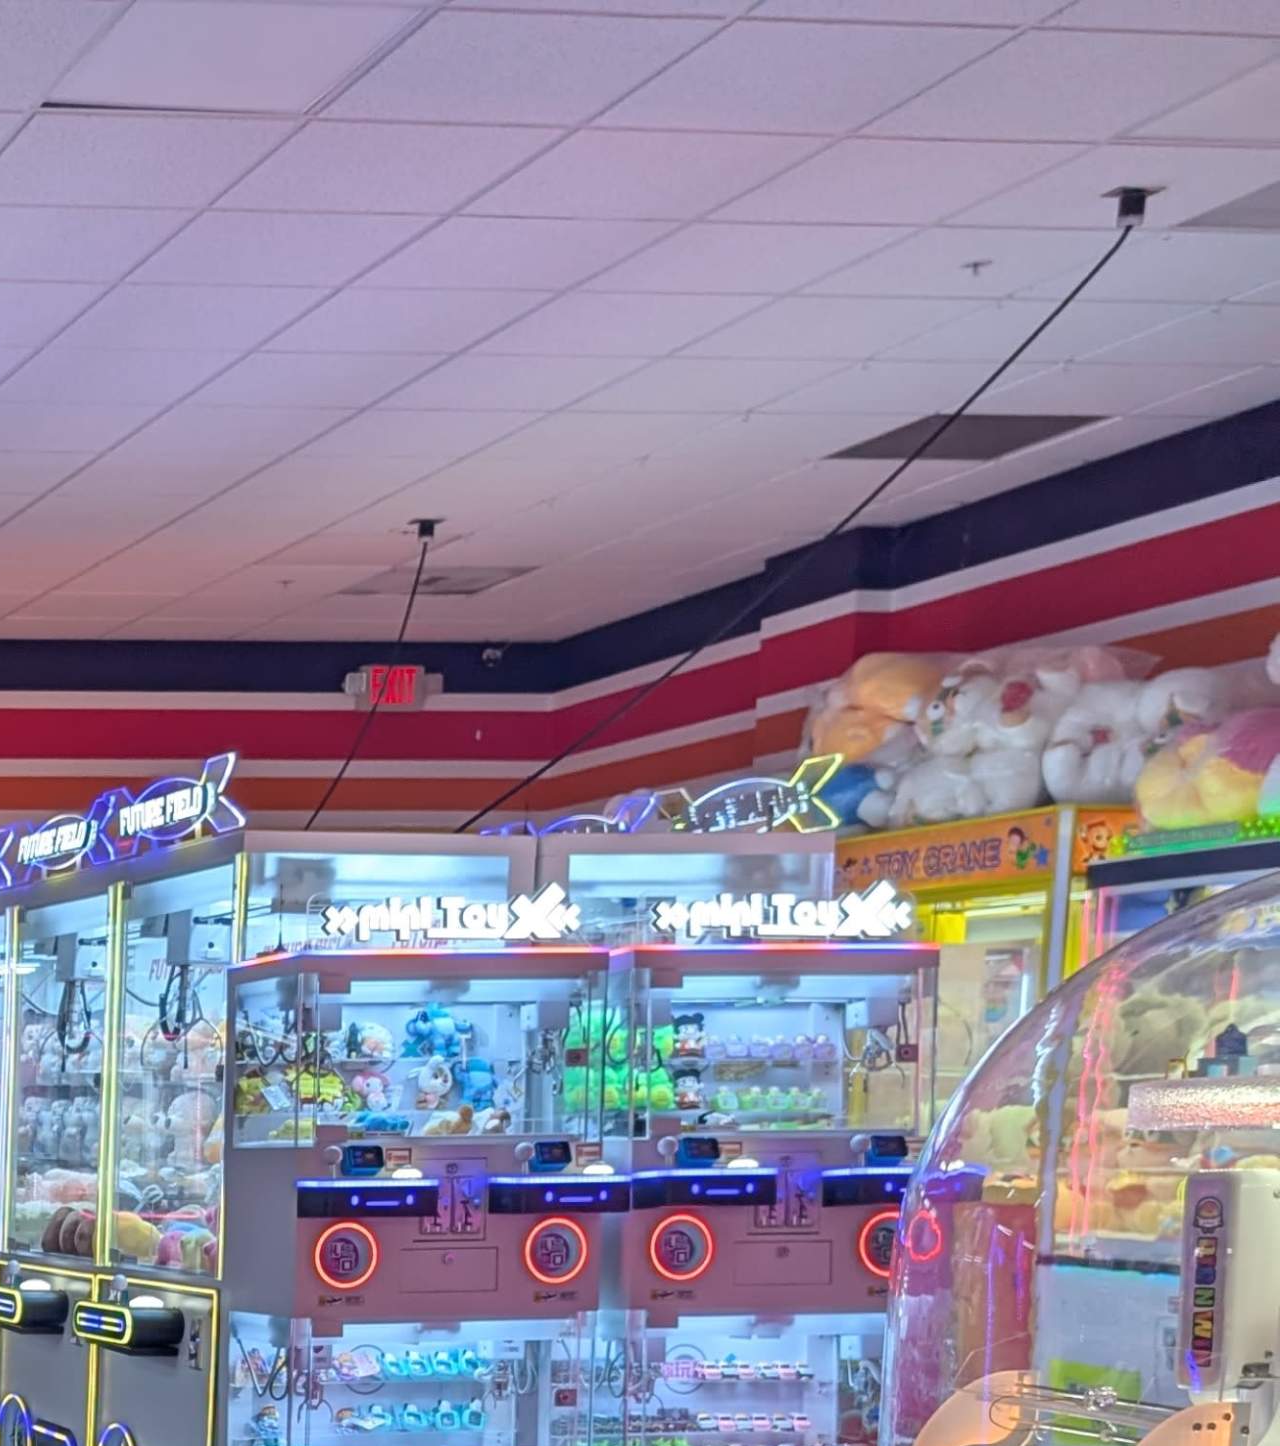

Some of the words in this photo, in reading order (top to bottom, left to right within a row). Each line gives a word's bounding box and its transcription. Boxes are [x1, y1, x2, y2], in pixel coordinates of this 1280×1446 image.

[370, 667, 417, 705] EXIT
[120, 802, 164, 836] FUTURE
[165, 786, 203, 823] FIELD
[18, 828, 54, 864] FUTURE
[55, 821, 87, 850] FIELD
[875, 850, 919, 880] TOY
